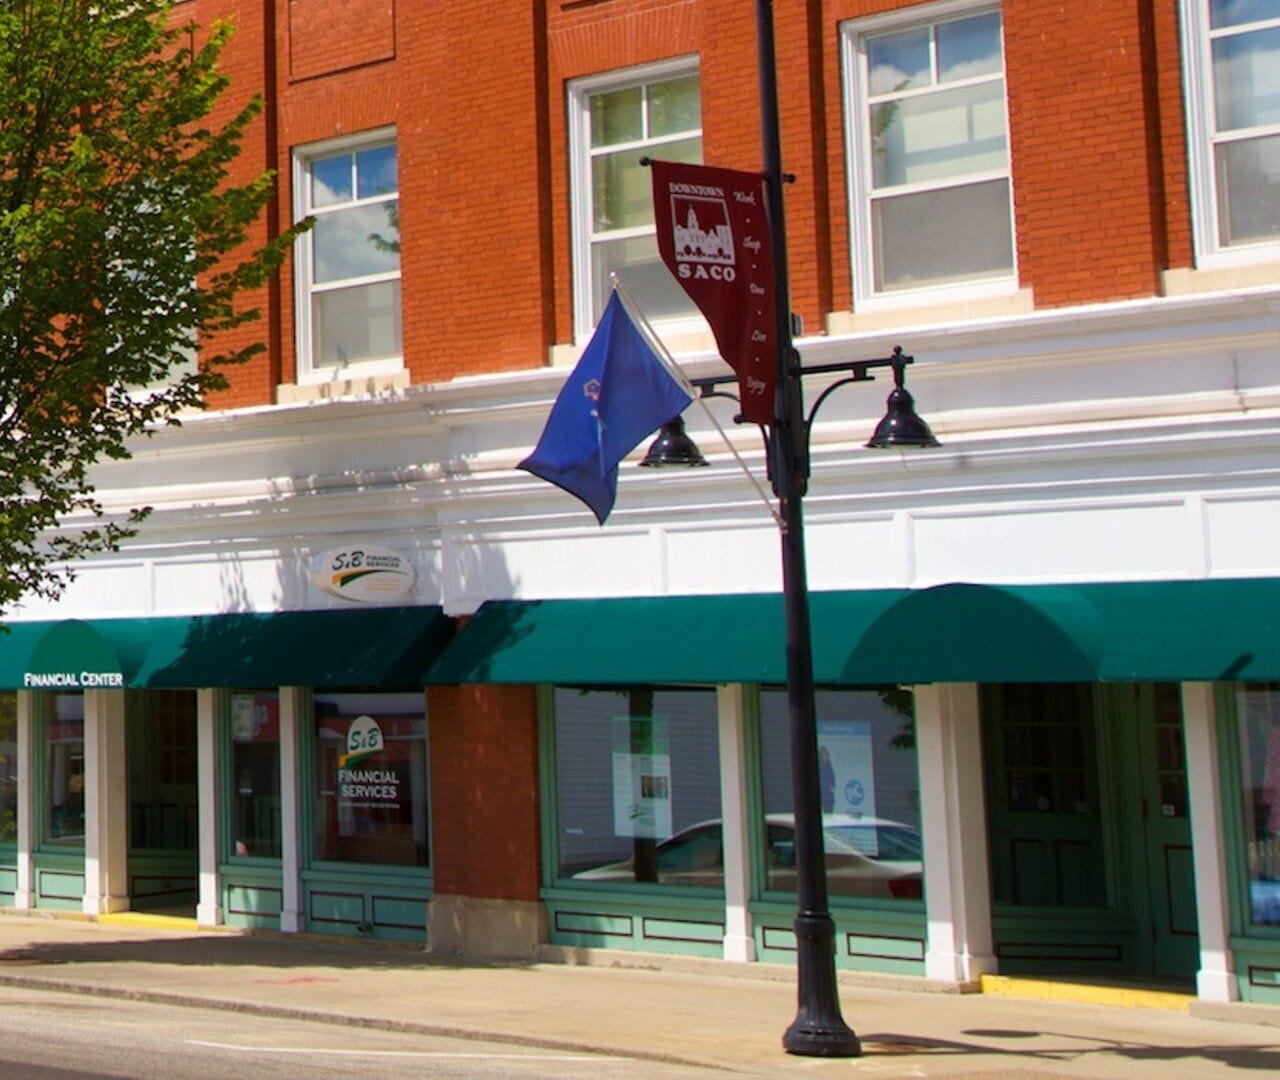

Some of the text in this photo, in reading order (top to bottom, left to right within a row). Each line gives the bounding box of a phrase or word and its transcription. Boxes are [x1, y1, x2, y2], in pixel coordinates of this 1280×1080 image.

[669, 182, 725, 197] DOWNTOWN
[678, 263, 736, 282] SACO
[24, 672, 123, 686] FINANCIAL CENTER
[338, 770, 400, 784] FINANCIAL
[342, 785, 397, 798] SERVICES
